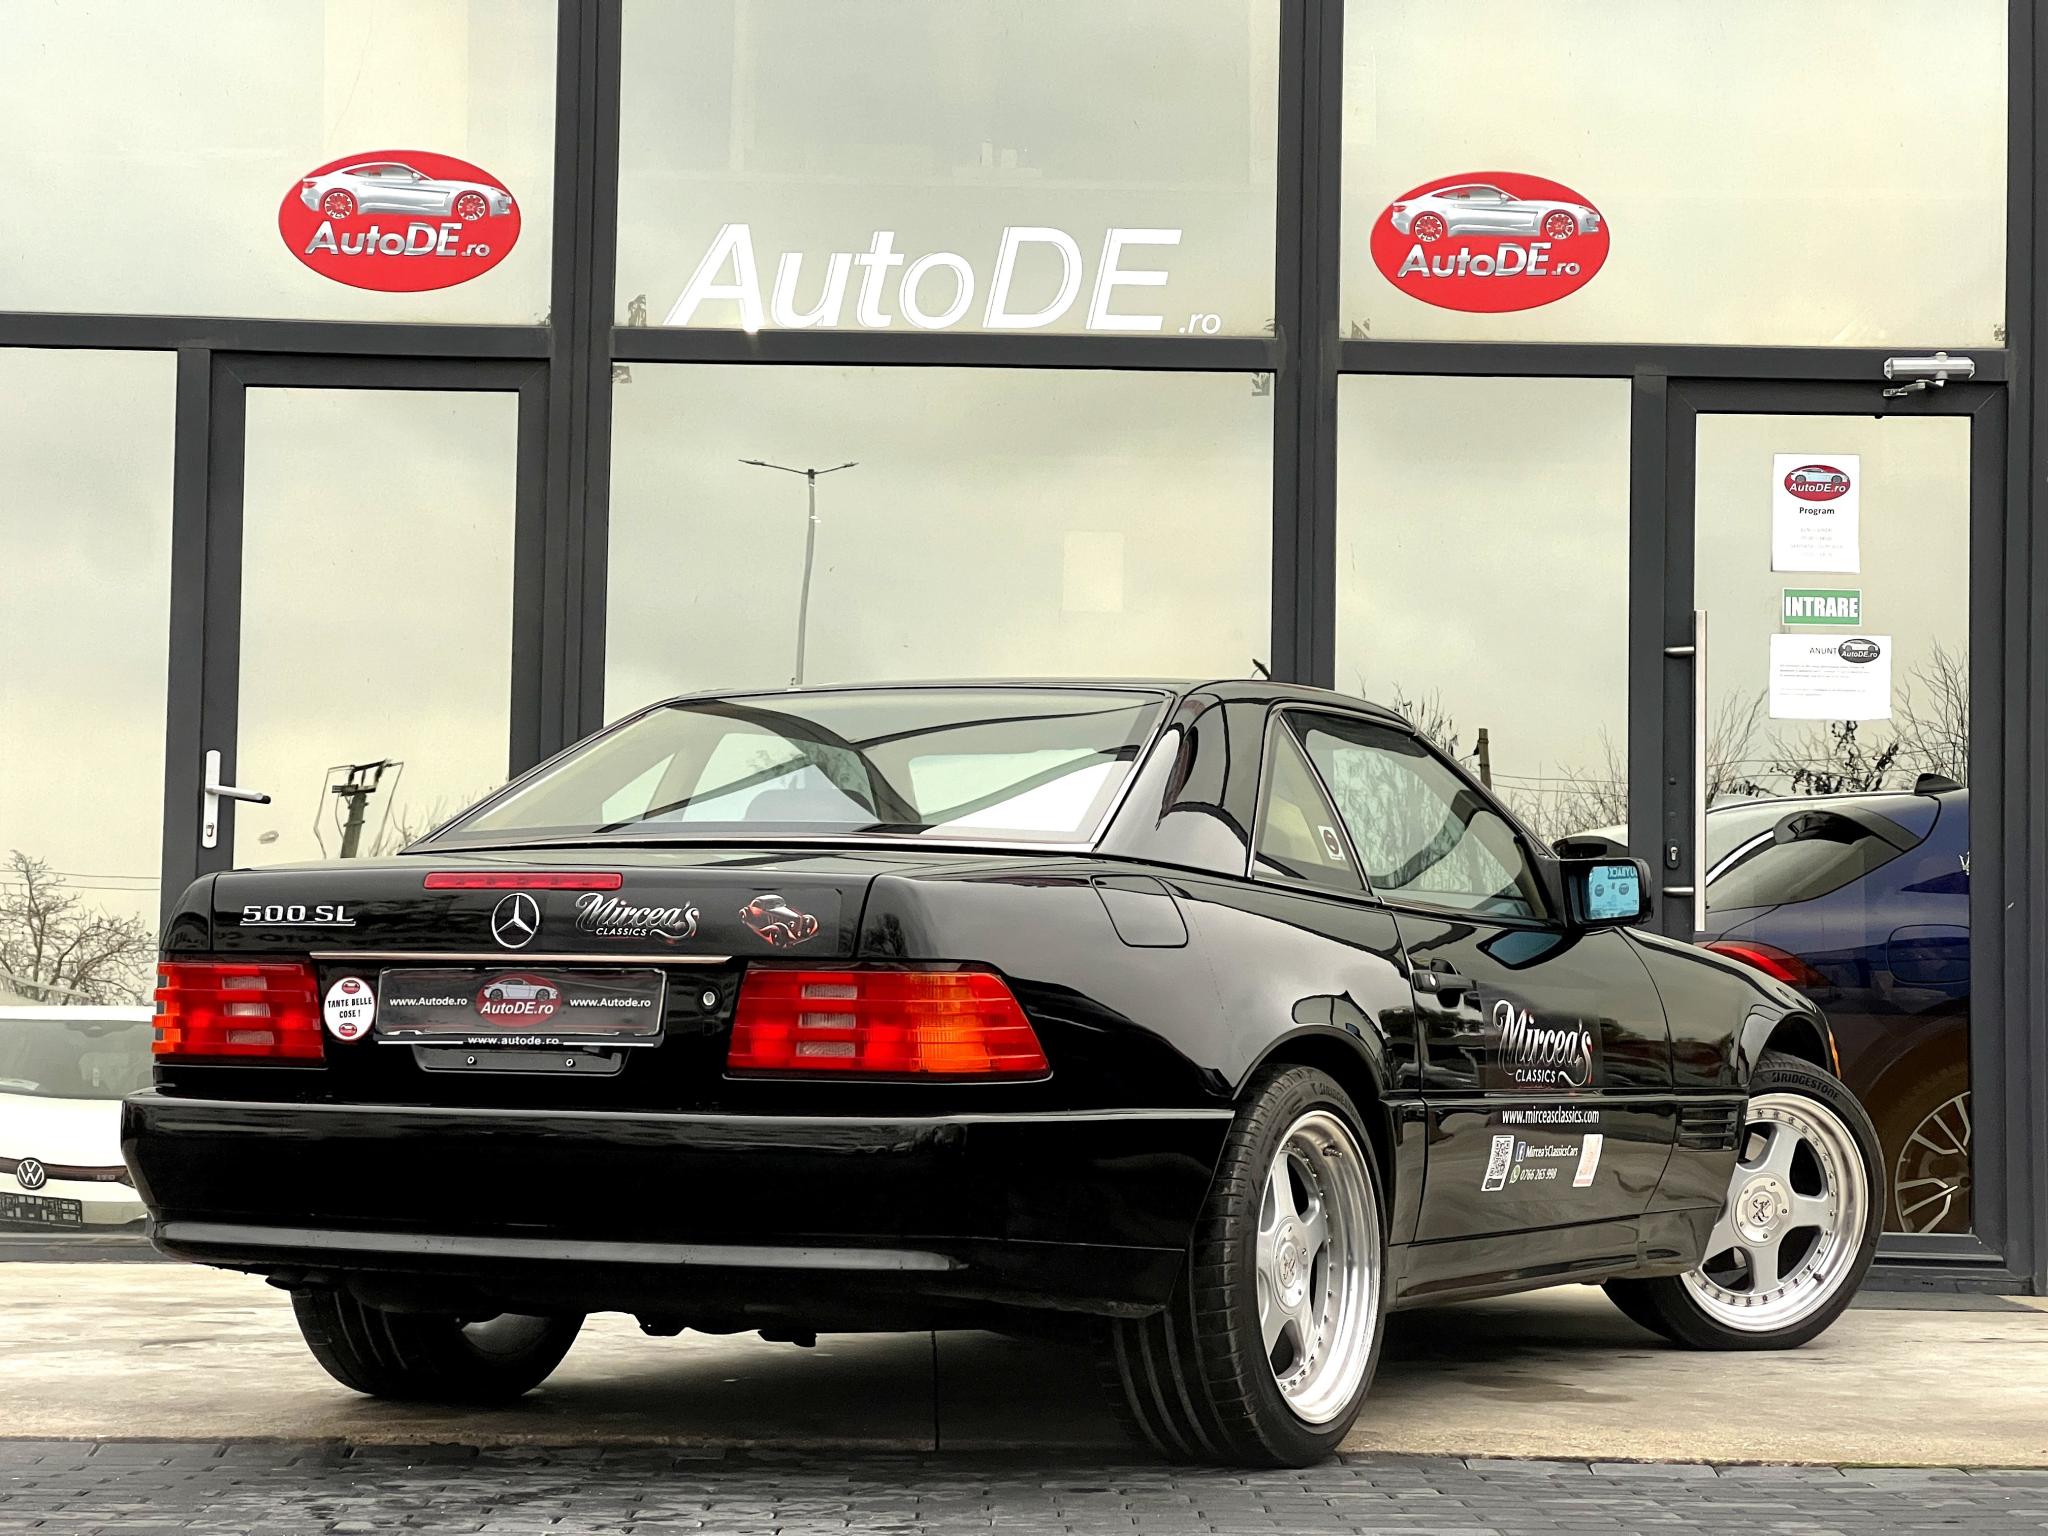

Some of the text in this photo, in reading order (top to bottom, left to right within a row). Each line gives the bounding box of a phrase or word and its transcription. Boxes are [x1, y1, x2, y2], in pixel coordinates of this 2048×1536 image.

[1789, 483, 1846, 493] AutoDE.ro
[1799, 507, 1835, 515] Program
[1785, 596, 1859, 617] INTRARE
[1841, 650, 1878, 658] AutoDE.ro
[242, 905, 354, 921] 500 SL
[575, 892, 699, 940] Mircea's
[595, 927, 647, 937] CLASSICS
[328, 997, 372, 1008] TANTE BELLE
[390, 997, 467, 1006] www.Autode.ro
[570, 998, 651, 1007] www.Autode.ro
[480, 1001, 554, 1015] AutoDE.ro
[340, 1010, 356, 1018] COSE
[467, 1037, 559, 1046] www.autode.ro
[1492, 1000, 1593, 1087] Mircea's
[1515, 1069, 1556, 1083] CLASSICS
[1502, 1106, 1600, 1123] www.mirceasclassics.com
